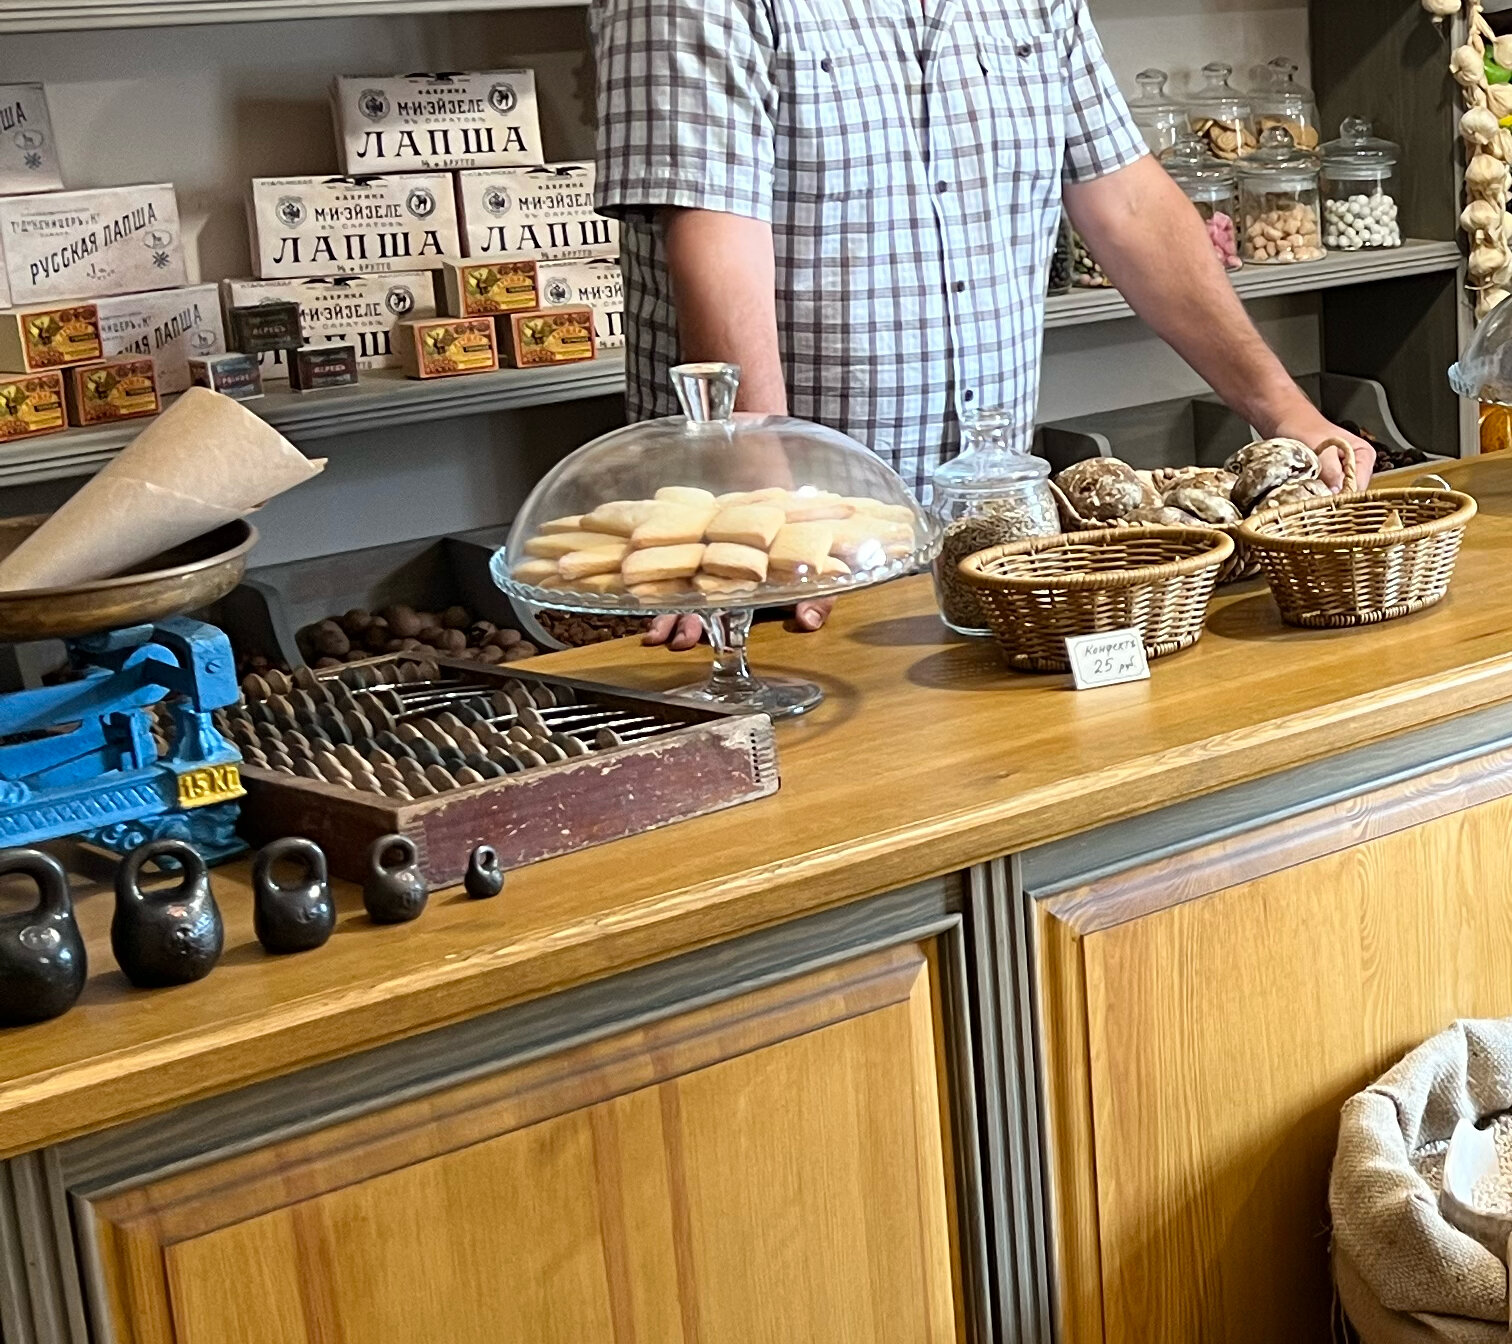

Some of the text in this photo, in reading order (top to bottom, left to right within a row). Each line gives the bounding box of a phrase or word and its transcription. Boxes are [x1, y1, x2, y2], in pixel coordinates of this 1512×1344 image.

[356, 125, 528, 159] ЛАПША
[272, 230, 445, 264] ЛАПША
[480, 219, 612, 253] ЛАПШ
[30, 231, 99, 286] РУССКАЯ
[1093, 657, 1115, 675] 25
